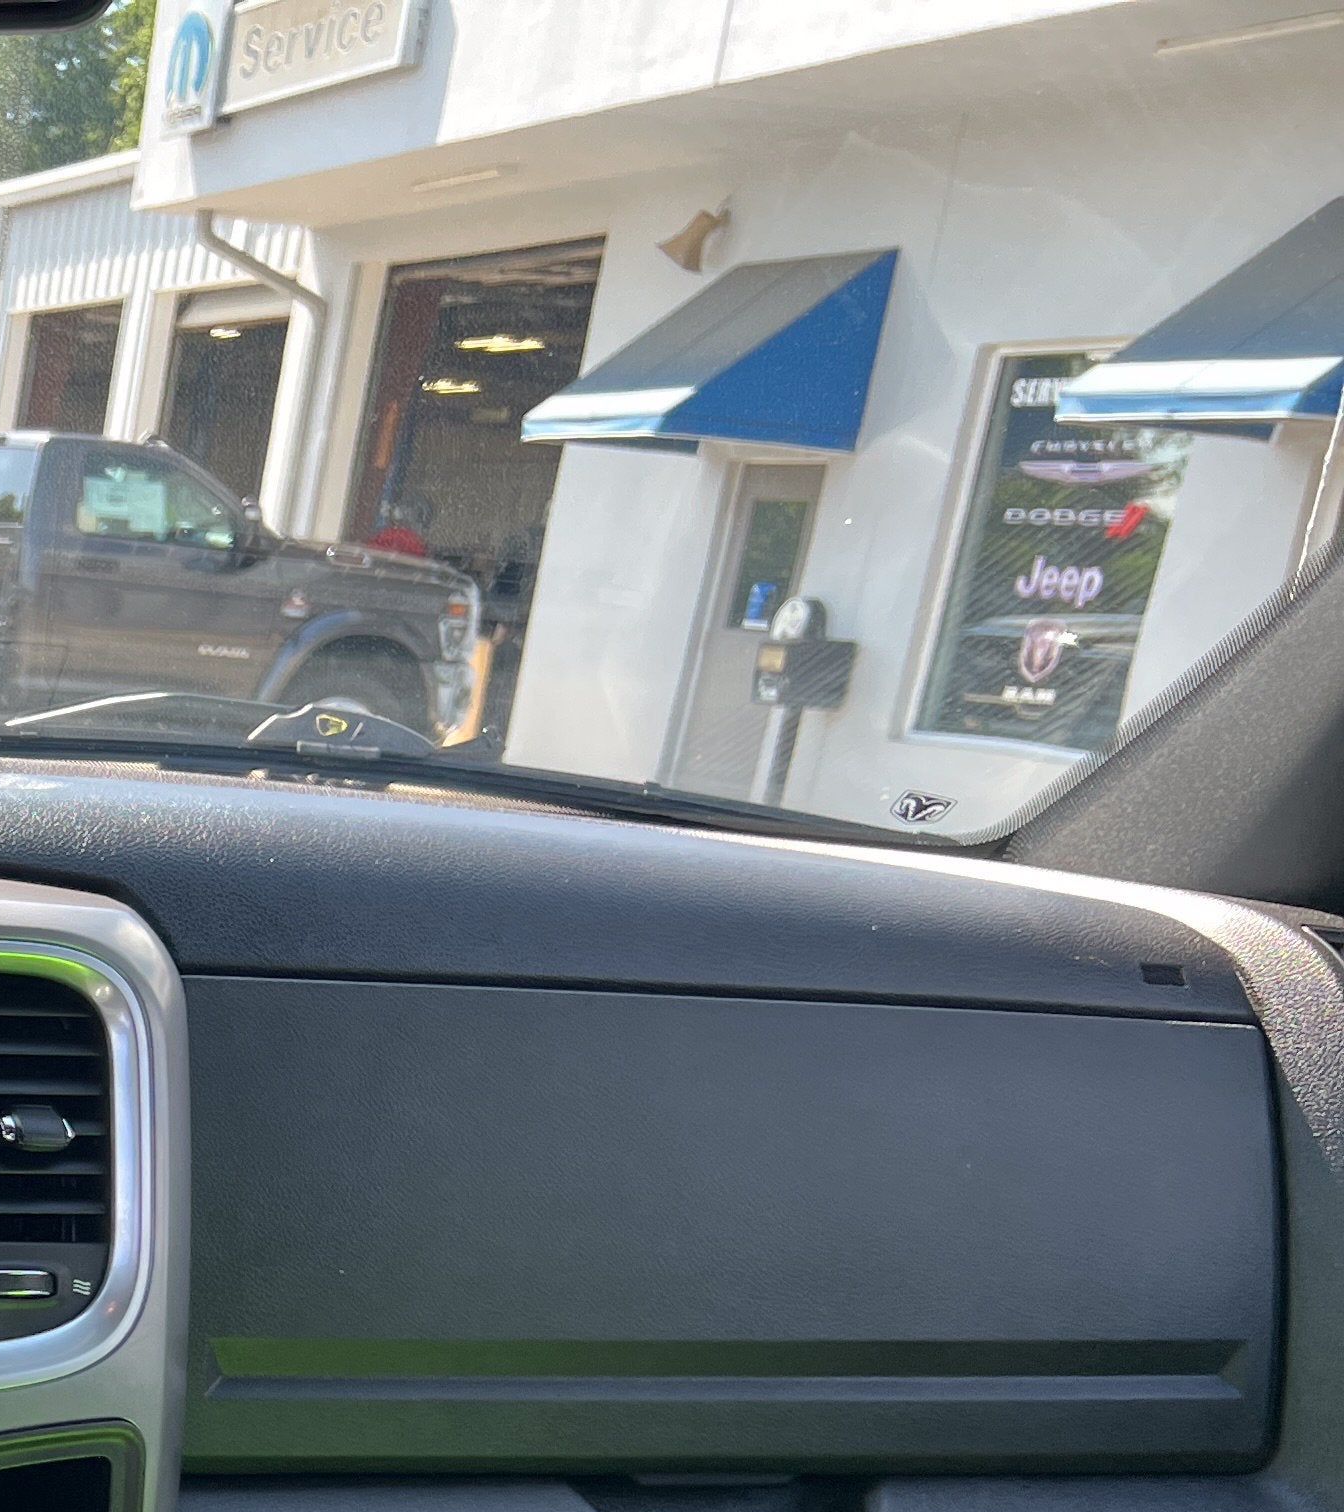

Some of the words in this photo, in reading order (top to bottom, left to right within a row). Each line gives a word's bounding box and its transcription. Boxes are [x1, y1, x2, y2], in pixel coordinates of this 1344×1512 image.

[239, 1, 387, 80] Service
[1003, 507, 1127, 527] DODGE
[1015, 554, 1104, 608] Jeep
